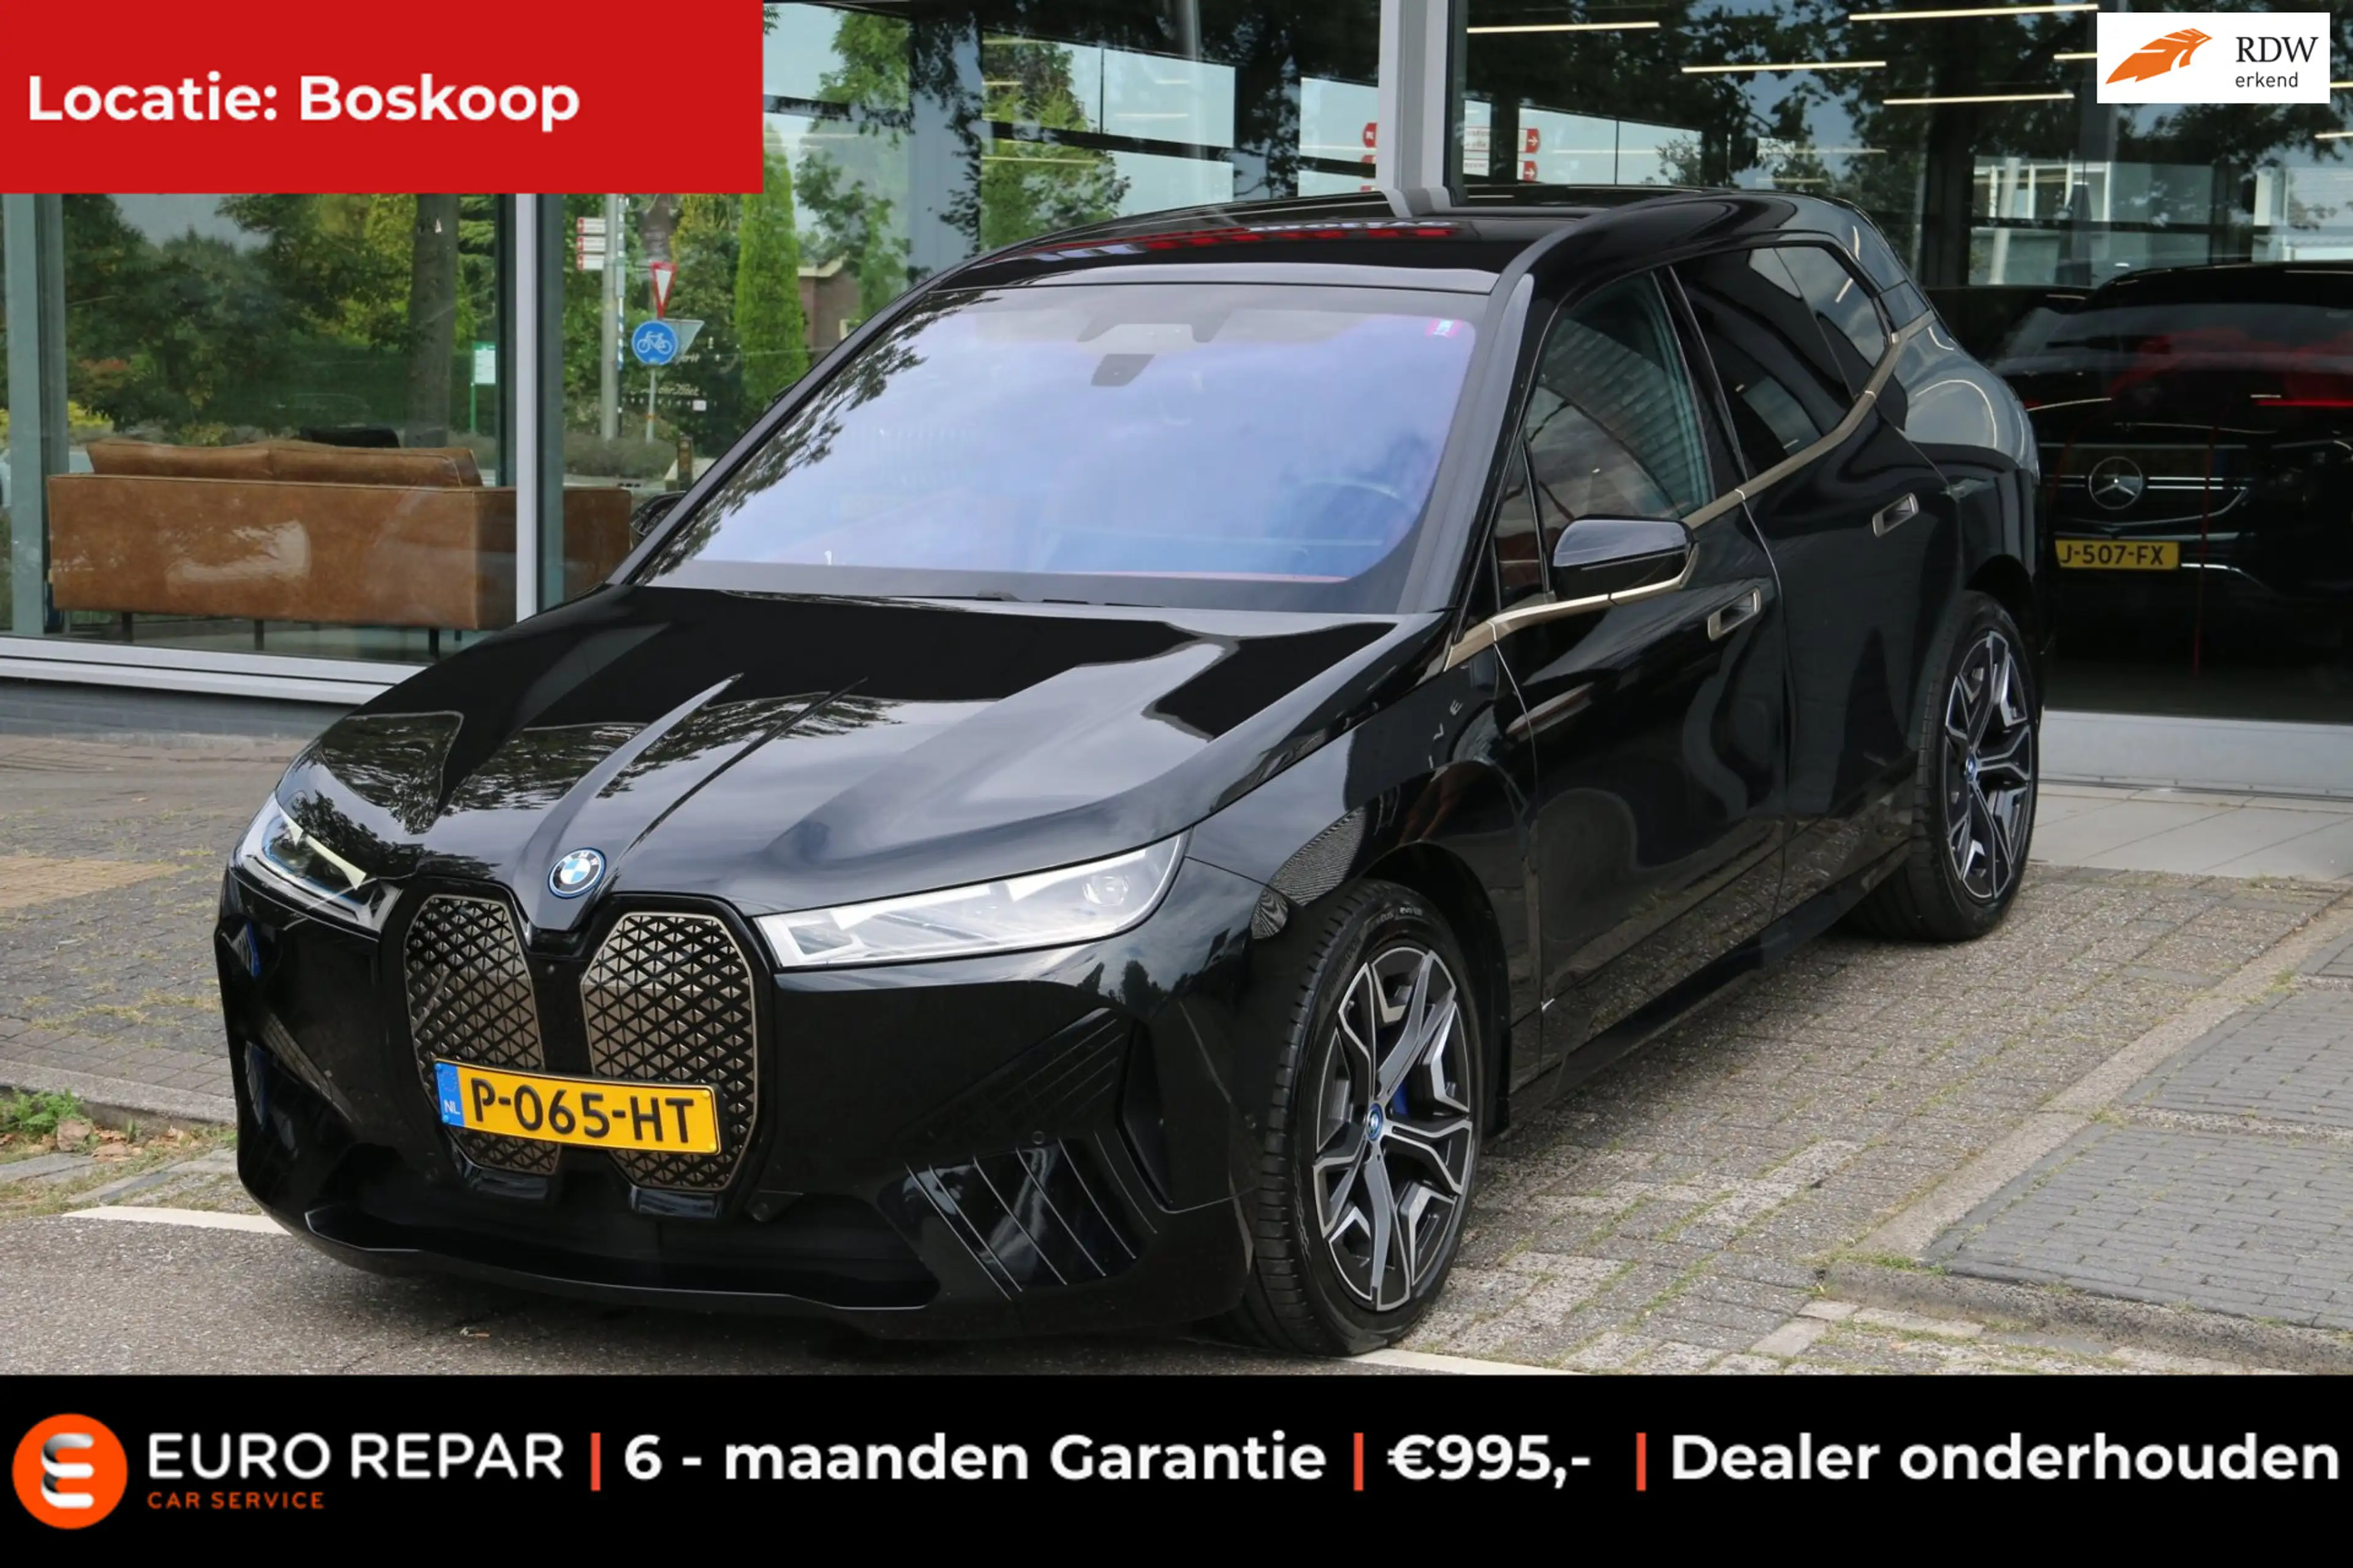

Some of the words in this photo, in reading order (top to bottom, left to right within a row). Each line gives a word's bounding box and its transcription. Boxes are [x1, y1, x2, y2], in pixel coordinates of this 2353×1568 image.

[2061, 543, 2164, 566] J-507-FX
[443, 1099, 461, 1116] NL
[470, 1077, 695, 1143] P-065-HT
